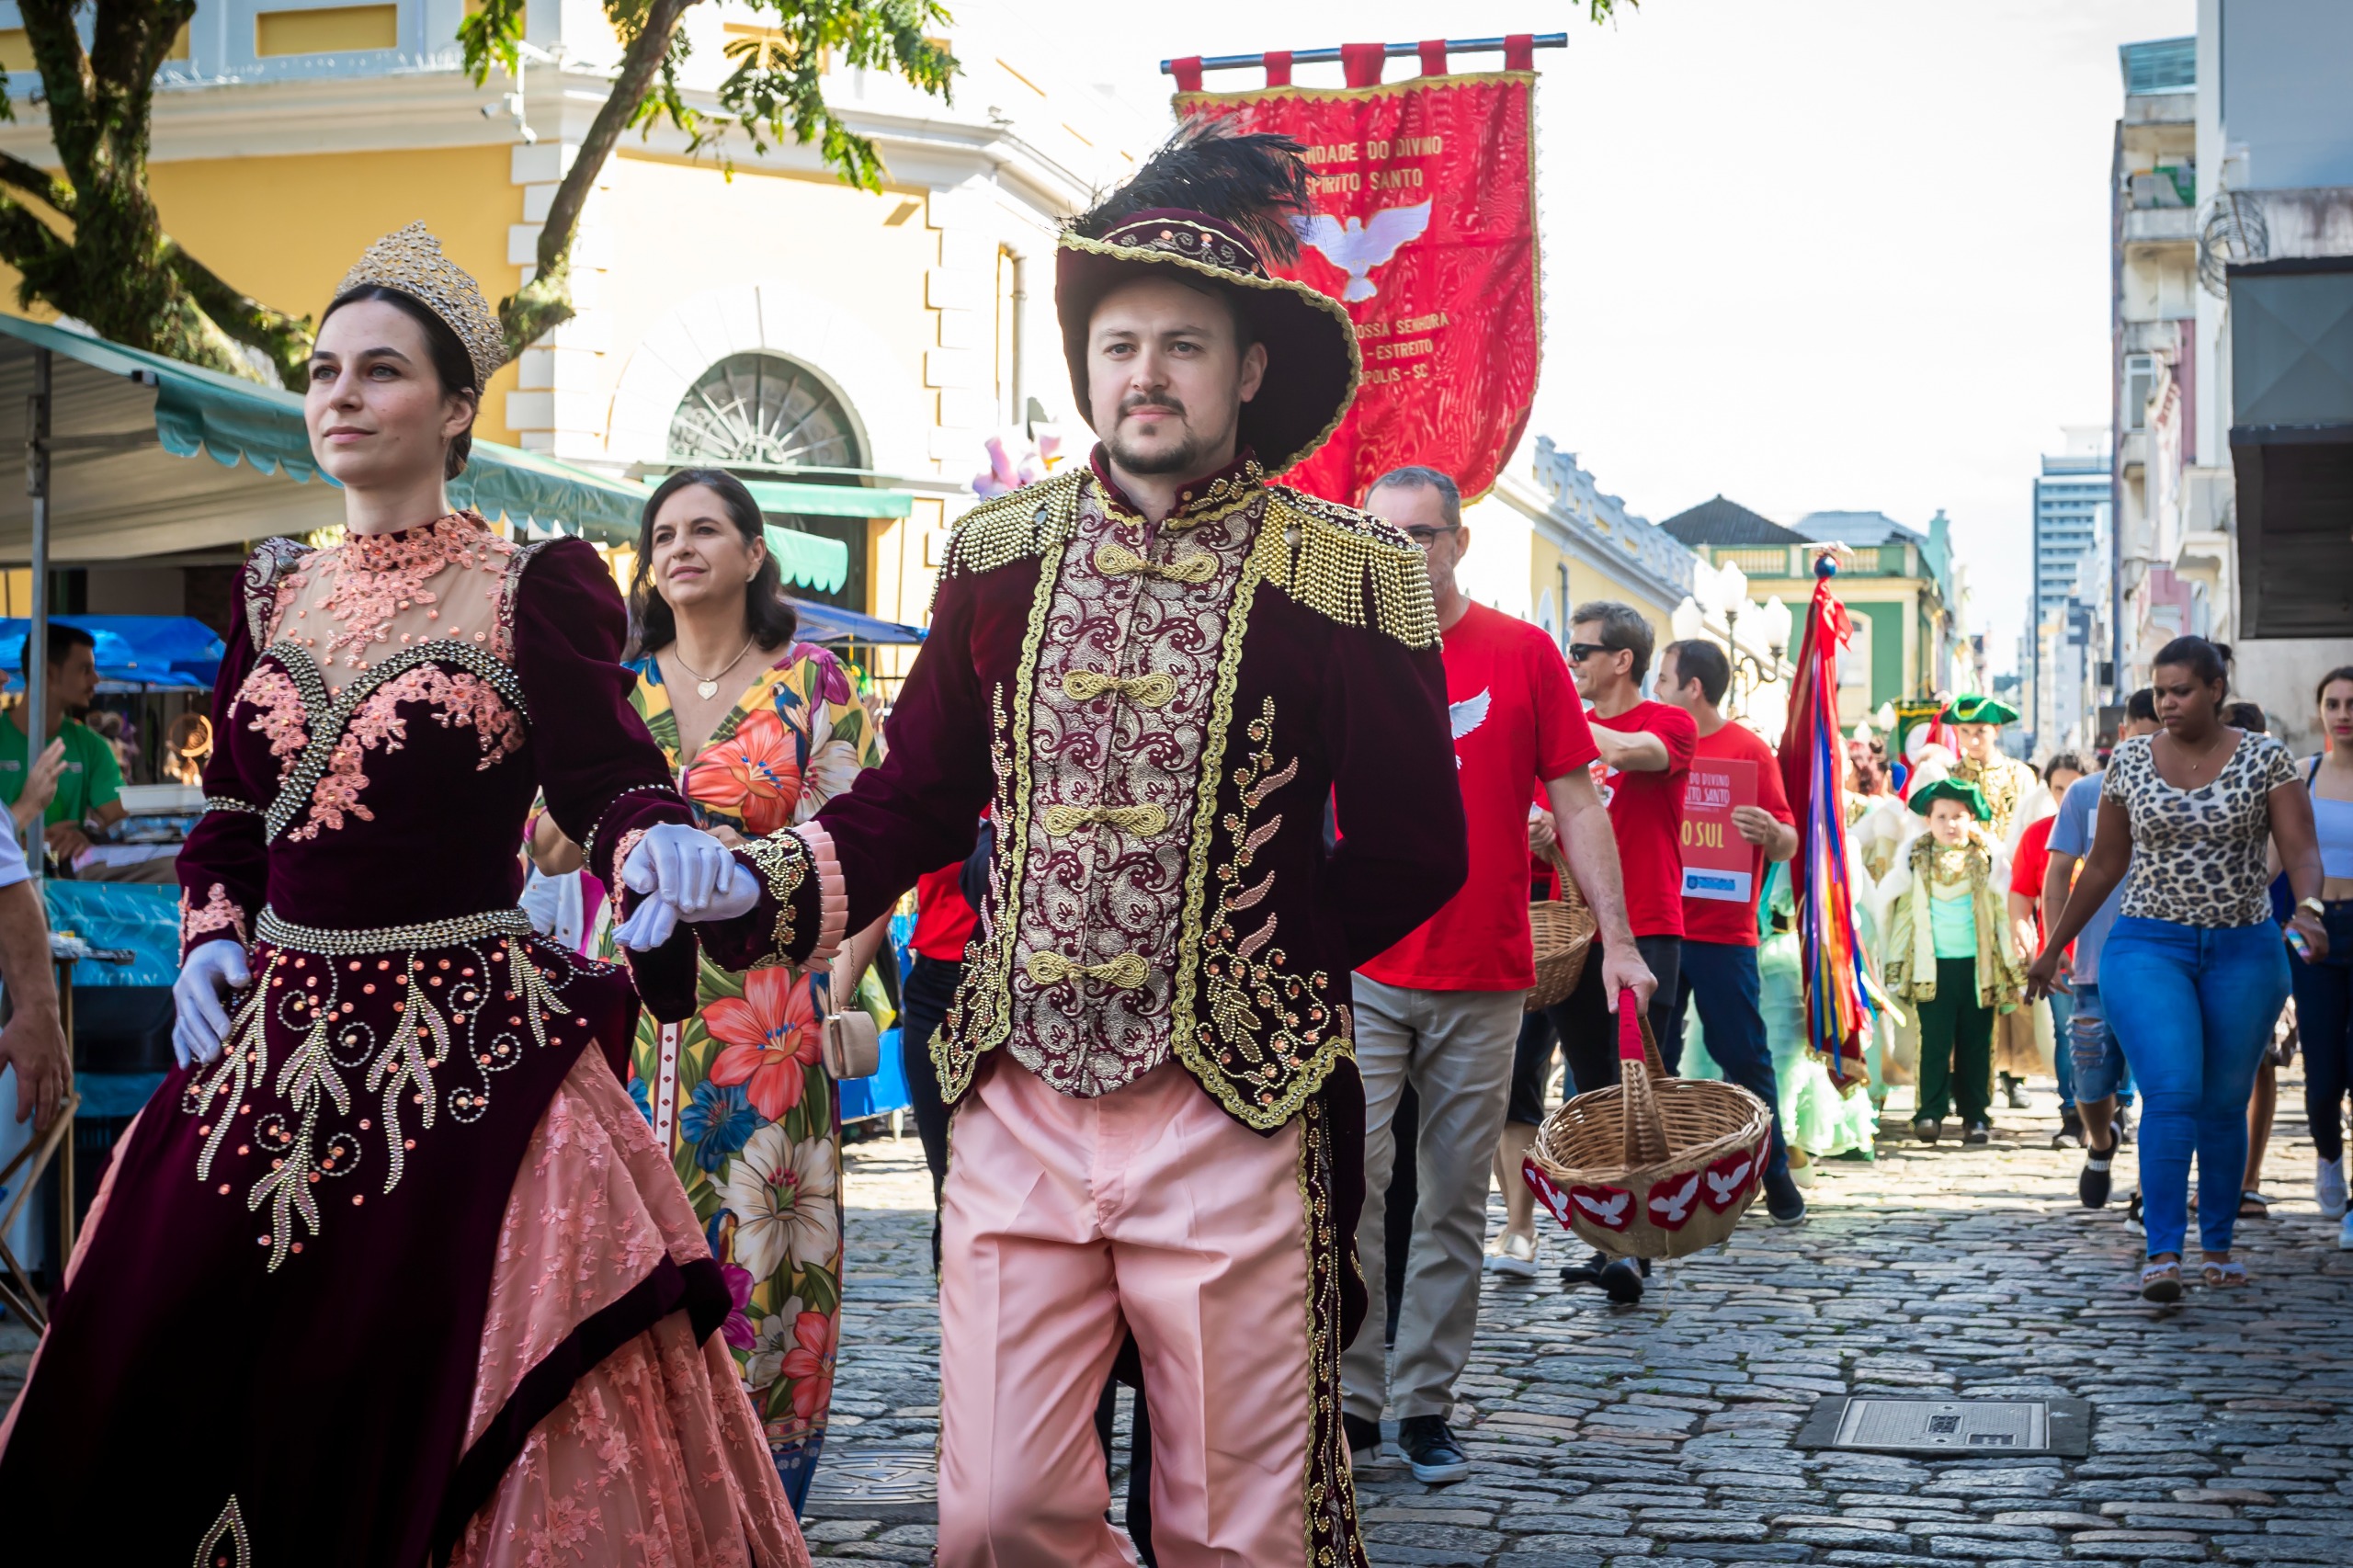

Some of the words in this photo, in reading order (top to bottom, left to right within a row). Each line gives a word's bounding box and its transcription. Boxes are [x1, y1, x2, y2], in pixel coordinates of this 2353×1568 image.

[1290, 142, 1358, 165] NDADE
[1367, 140, 1390, 160] DO
[1304, 169, 1360, 194] SPÍRITO
[1370, 168, 1423, 190] SANTO
[1356, 323, 1391, 339] OSSA
[1376, 338, 1434, 360] ESTREITO
[1413, 363, 1428, 380] SC
[1689, 772, 1700, 785] DO
[1701, 772, 1730, 788] DIVINO
[1686, 786, 1701, 802] ITO
[1704, 788, 1731, 805] SANTO
[1695, 821, 1724, 849] SUL
